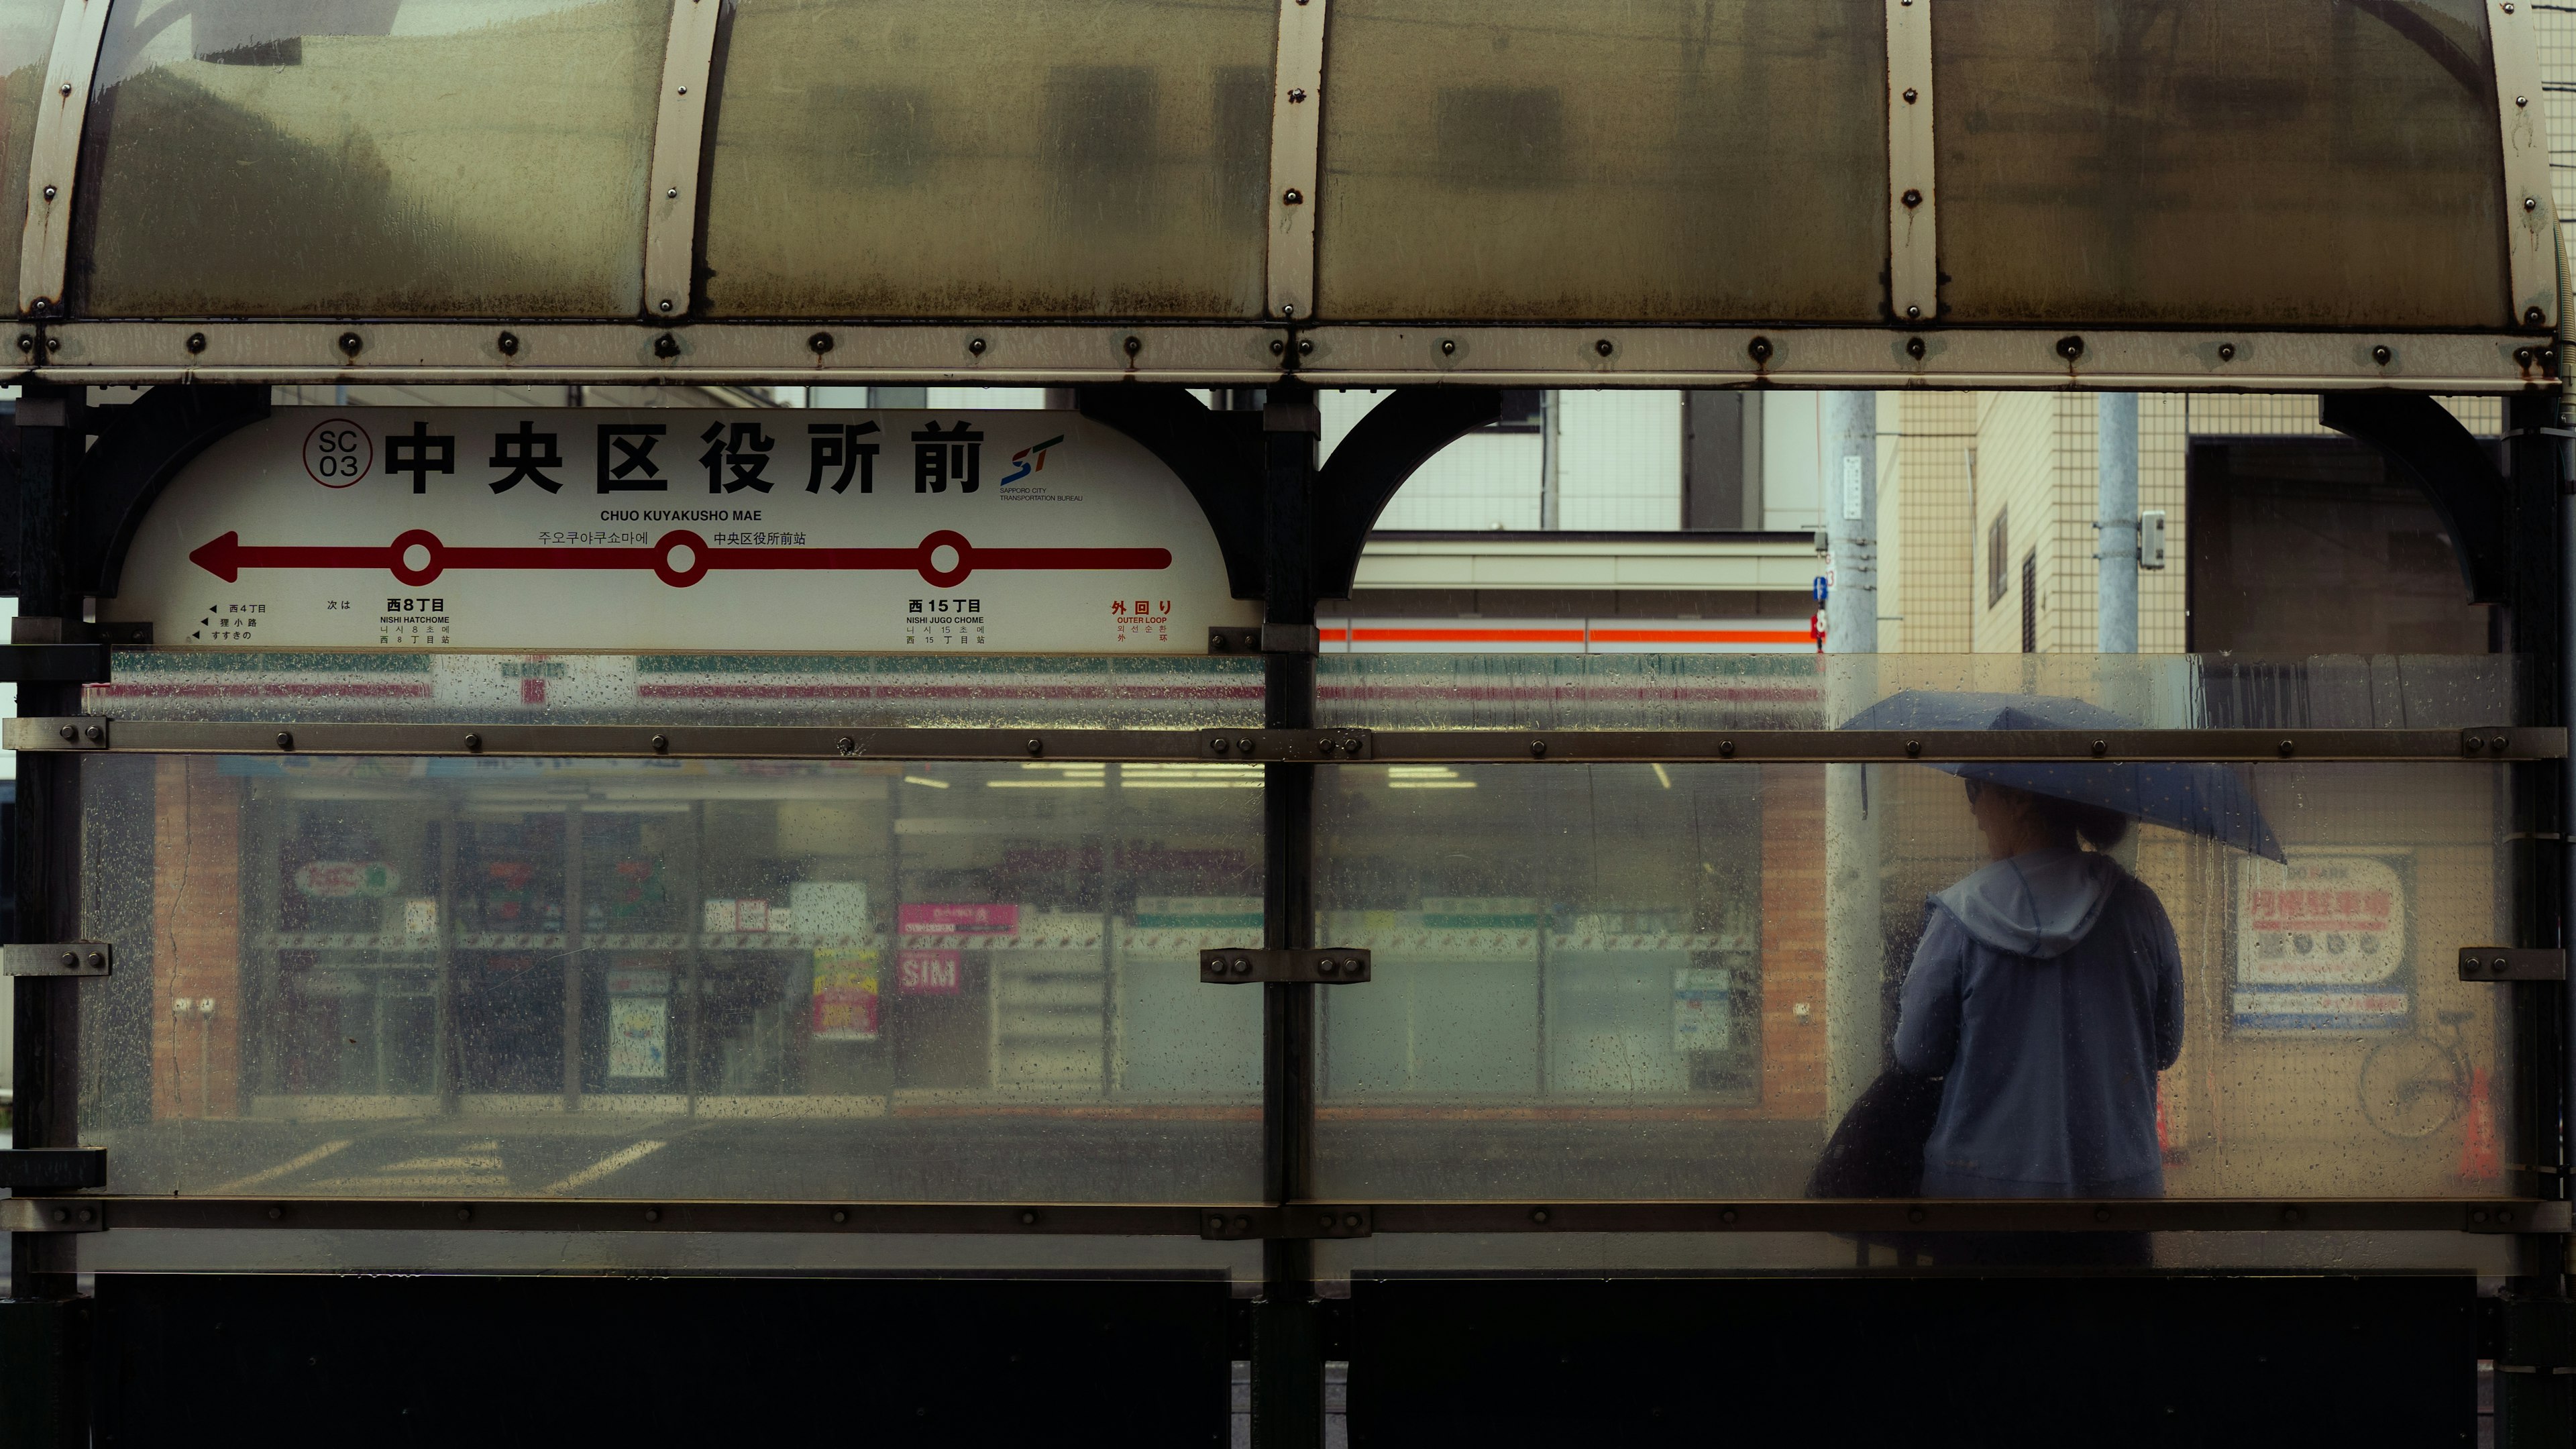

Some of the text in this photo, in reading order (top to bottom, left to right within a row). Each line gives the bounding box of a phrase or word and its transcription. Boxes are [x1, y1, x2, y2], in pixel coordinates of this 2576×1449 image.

[319, 430, 358, 453] SC
[384, 420, 984, 494] 中央区役所前
[319, 455, 358, 478] 03
[600, 510, 762, 521] CHUO KUYAKUSHO MAE
[538, 531, 648, 545] 주오쿠야쿠쇼마에
[714, 531, 806, 545] 中央区役所前站
[229, 604, 266, 613] 西4丁目
[327, 600, 351, 610] 次は
[387, 598, 444, 612] 西8丁目
[908, 599, 981, 613] 西15丁目
[1111, 600, 1171, 615] 外回り
[219, 618, 258, 627] 狸小路
[380, 616, 450, 624] NISHI HATCHOME
[211, 631, 252, 640] すすきの
[901, 958, 955, 987] SIM
